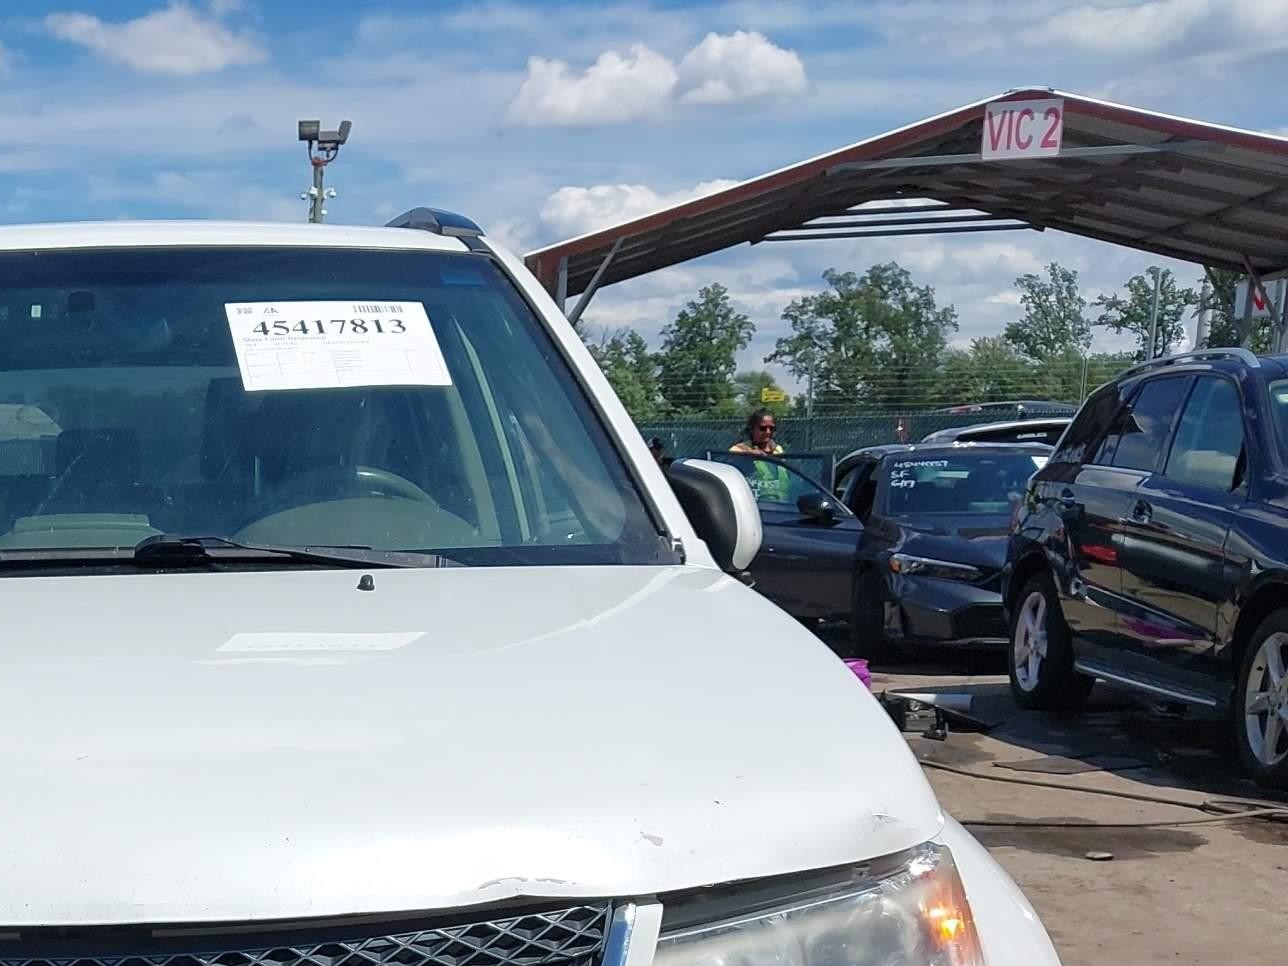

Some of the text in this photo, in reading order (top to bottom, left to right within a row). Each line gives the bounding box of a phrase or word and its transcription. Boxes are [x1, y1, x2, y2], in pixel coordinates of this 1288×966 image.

[987, 107, 1061, 151] VIC 2
[253, 318, 407, 336] 45417813
